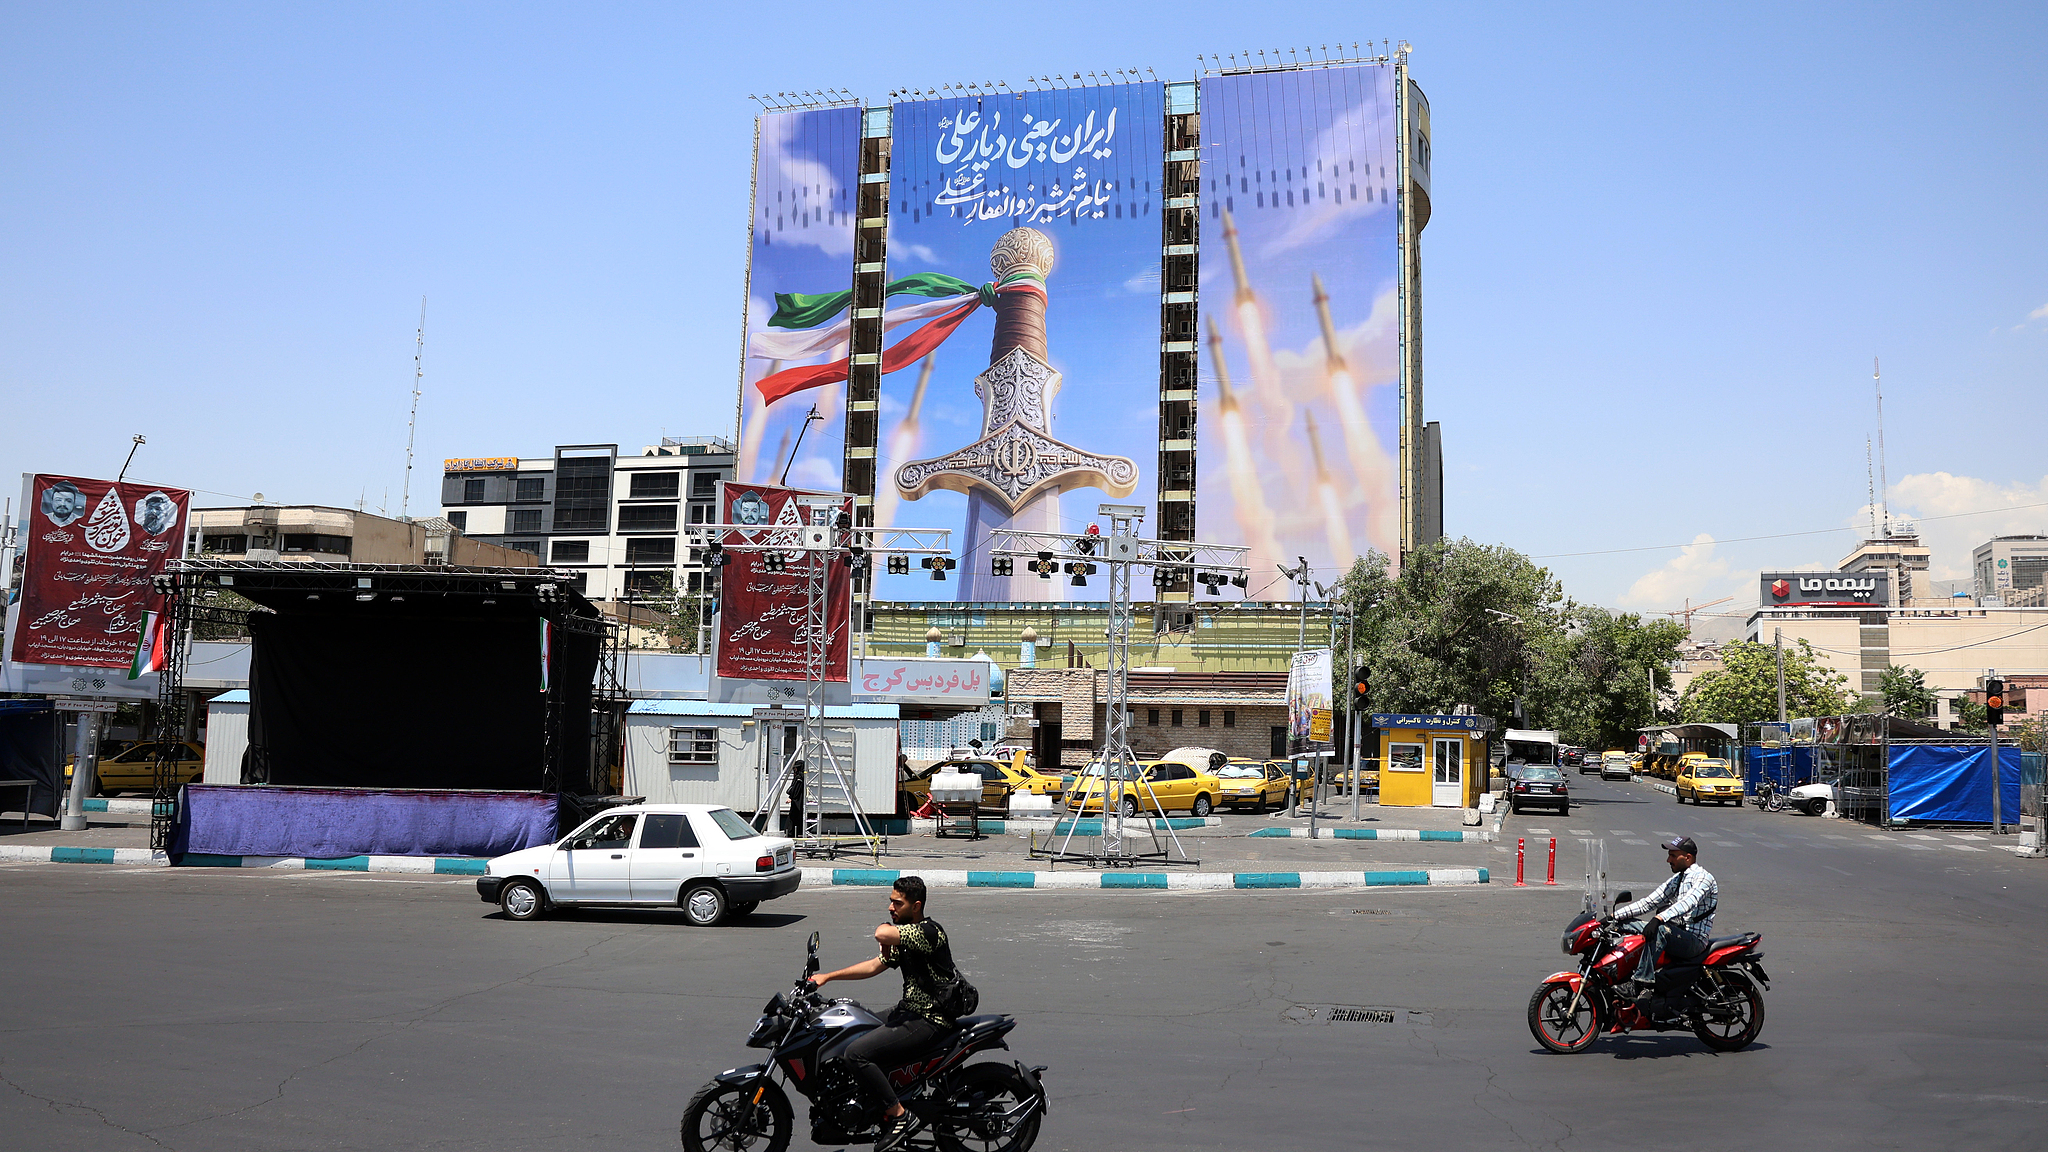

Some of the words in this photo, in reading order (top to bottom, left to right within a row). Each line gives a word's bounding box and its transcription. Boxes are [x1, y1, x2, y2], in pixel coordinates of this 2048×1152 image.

[936, 108, 981, 165] علی
[1006, 113, 1062, 169] یعنی
[1050, 106, 1117, 164] ایران
[934, 171, 988, 206] علی
[444, 460, 460, 470] ایران
[468, 459, 487, 469] انتقال
[487, 459, 504, 469] شرکت
[95, 528, 126, 549] خون
[1799, 576, 1823, 591] ما
[1825, 577, 1876, 598] بیمه
[103, 600, 126, 615] حاج
[58, 613, 82, 629] حاج
[788, 610, 808, 625] حاج
[47, 635, 59, 643] الی
[67, 637, 91, 645] ساعت
[752, 626, 772, 641] حاج
[90, 638, 97, 646] از
[745, 647, 754, 656] الی
[761, 648, 780, 656] ساعت
[780, 649, 786, 658] از
[862, 666, 907, 692] کرج
[906, 669, 960, 694] فردیس
[961, 668, 981, 692] پل
[1396, 716, 1421, 725] تاکسیرانی
[1425, 717, 1442, 726] نظارت
[1445, 717, 1461, 726] کنترل
